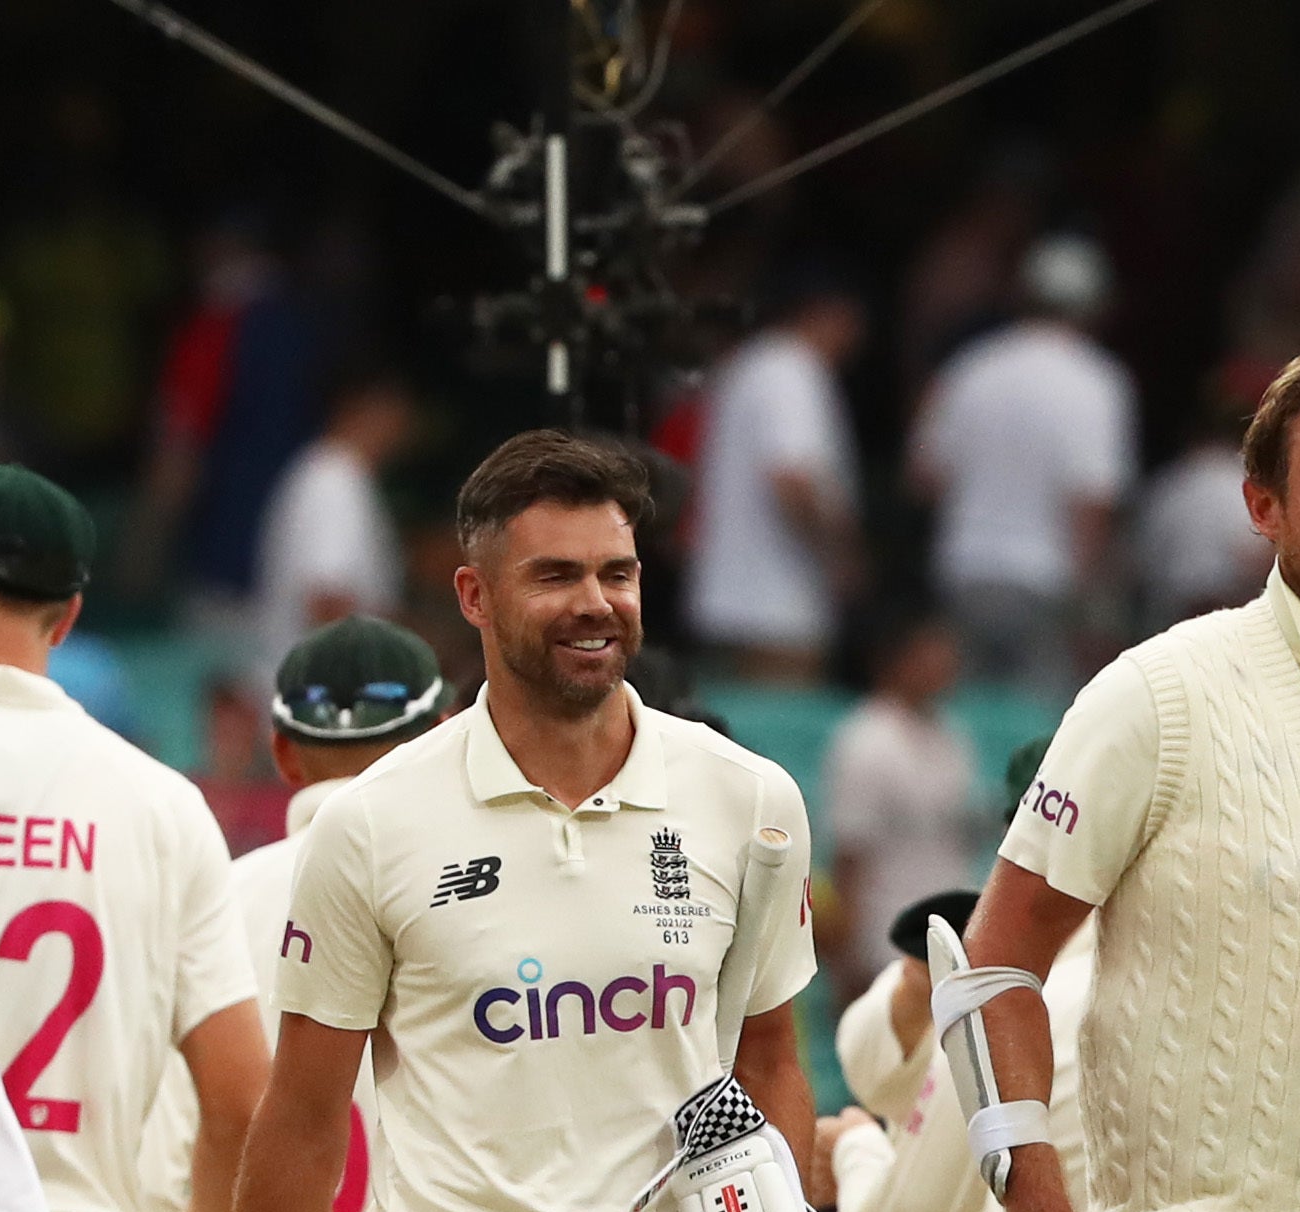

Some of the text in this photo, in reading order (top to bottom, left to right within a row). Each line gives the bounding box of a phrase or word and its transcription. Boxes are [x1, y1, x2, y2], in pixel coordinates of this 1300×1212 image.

[1022, 780, 1079, 836] nch
[633, 905, 711, 917] ASHES SERIES
[656, 918, 693, 928] 2021/22
[663, 930, 689, 945] 613
[473, 957, 696, 1044] cinch
[689, 1149, 751, 1180] PRESTIGE
